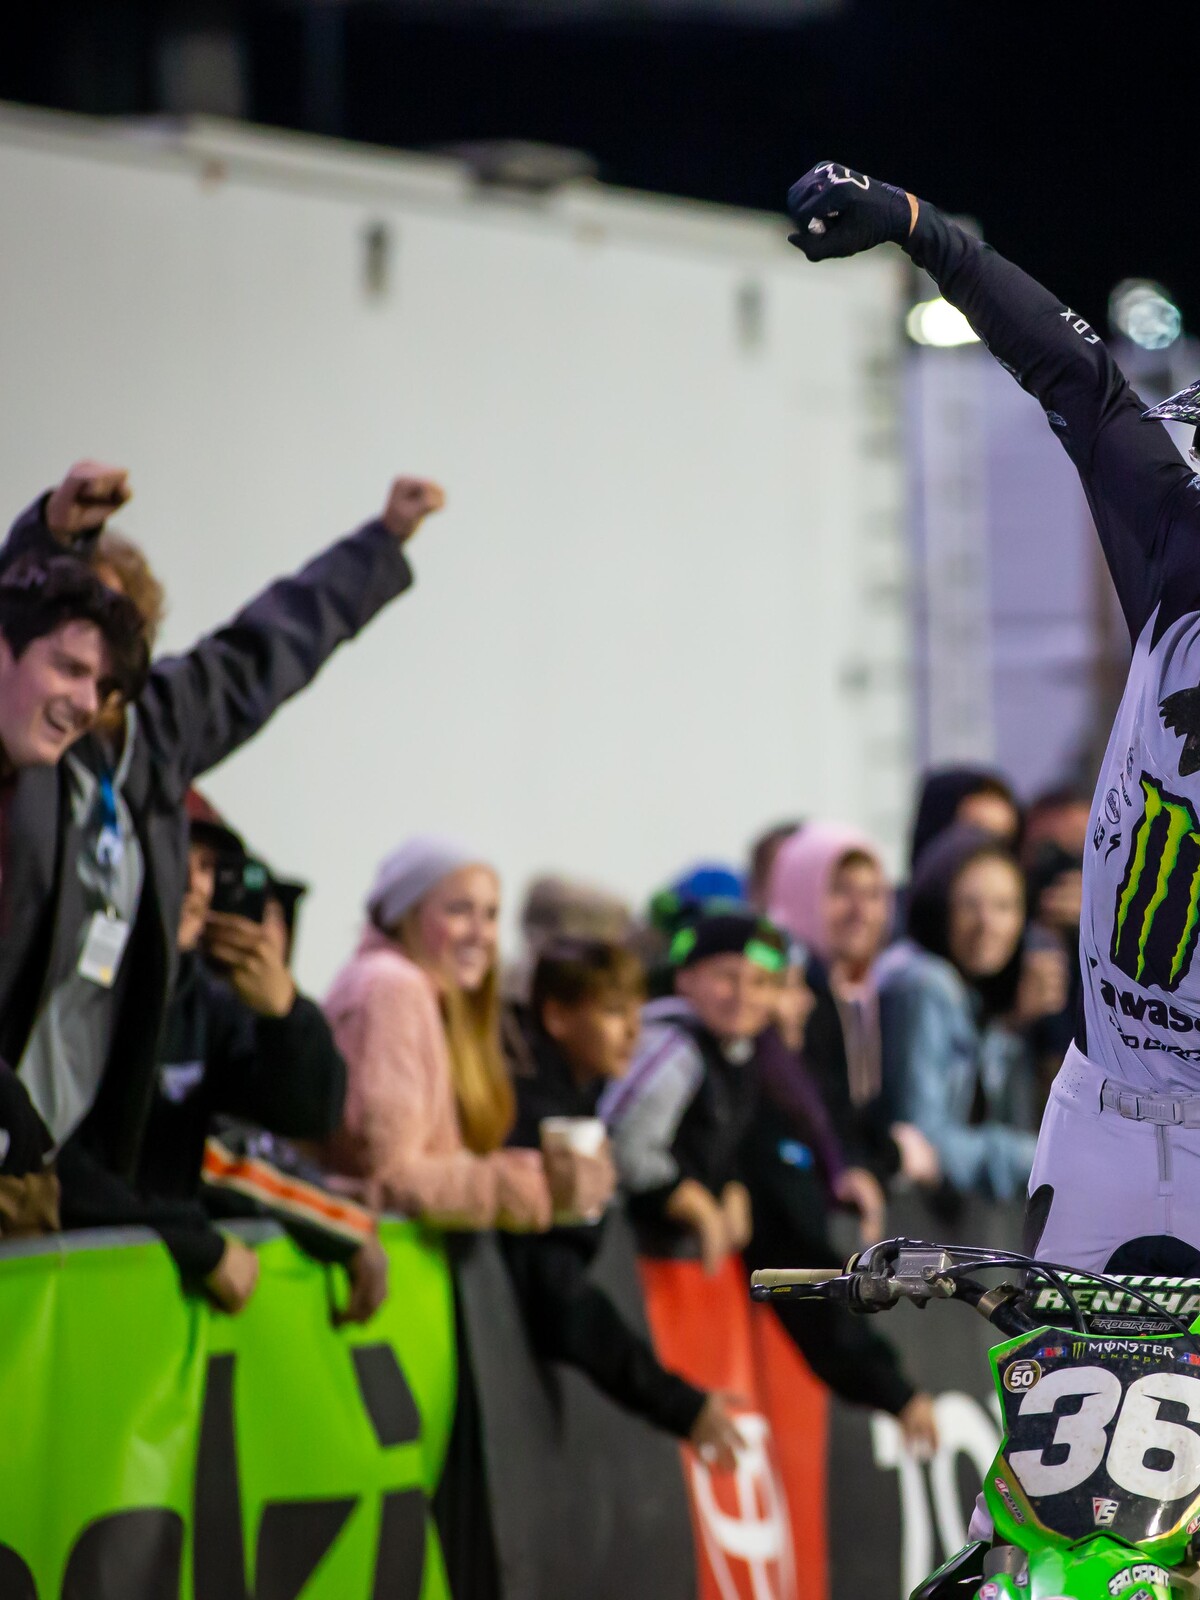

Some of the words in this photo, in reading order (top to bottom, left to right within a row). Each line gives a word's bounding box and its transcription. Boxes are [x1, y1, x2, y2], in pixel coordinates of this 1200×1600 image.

[1060, 307, 1101, 344] FOX
[1088, 1340, 1175, 1358] MONSTER
[1100, 1353, 1162, 1364] ENERGY
[1010, 1370, 1034, 1387] 50
